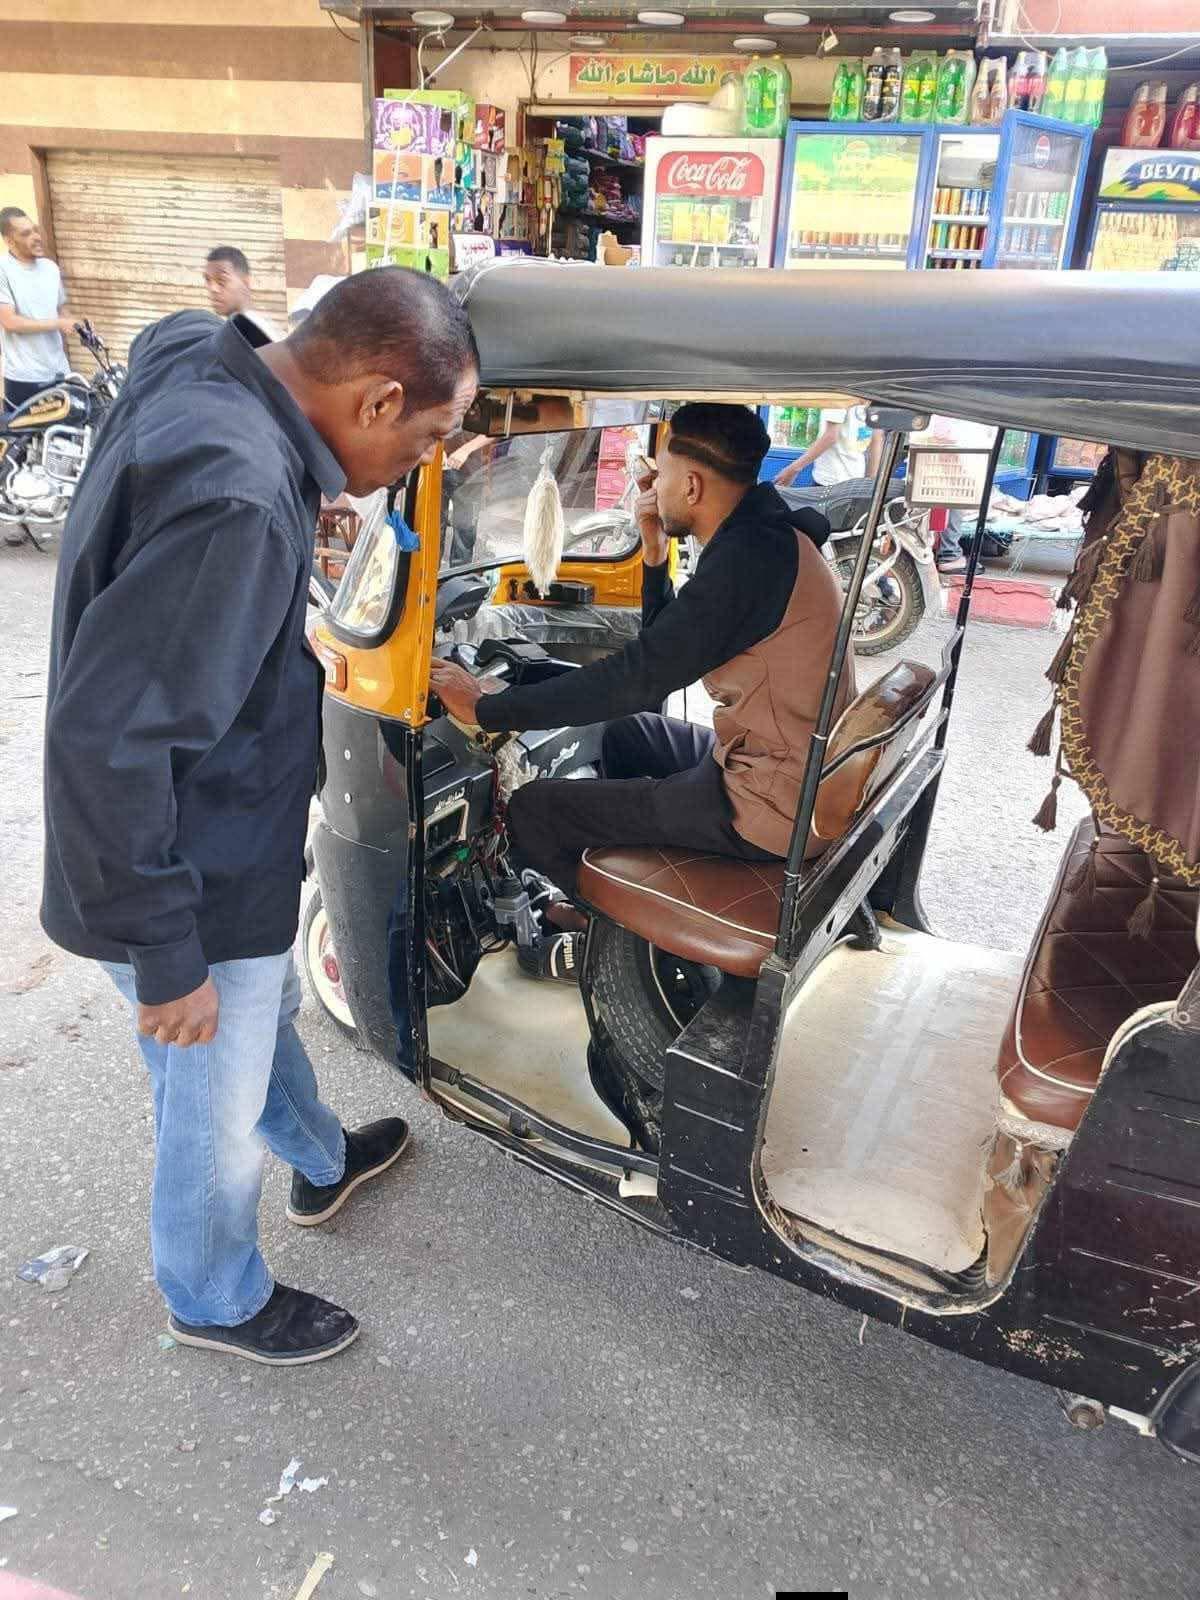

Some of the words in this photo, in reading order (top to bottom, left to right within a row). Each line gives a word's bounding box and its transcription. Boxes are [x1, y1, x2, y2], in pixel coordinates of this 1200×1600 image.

[576, 57, 614, 84] الله
[679, 57, 717, 86] الله
[667, 155, 753, 191] Coca-Cola
